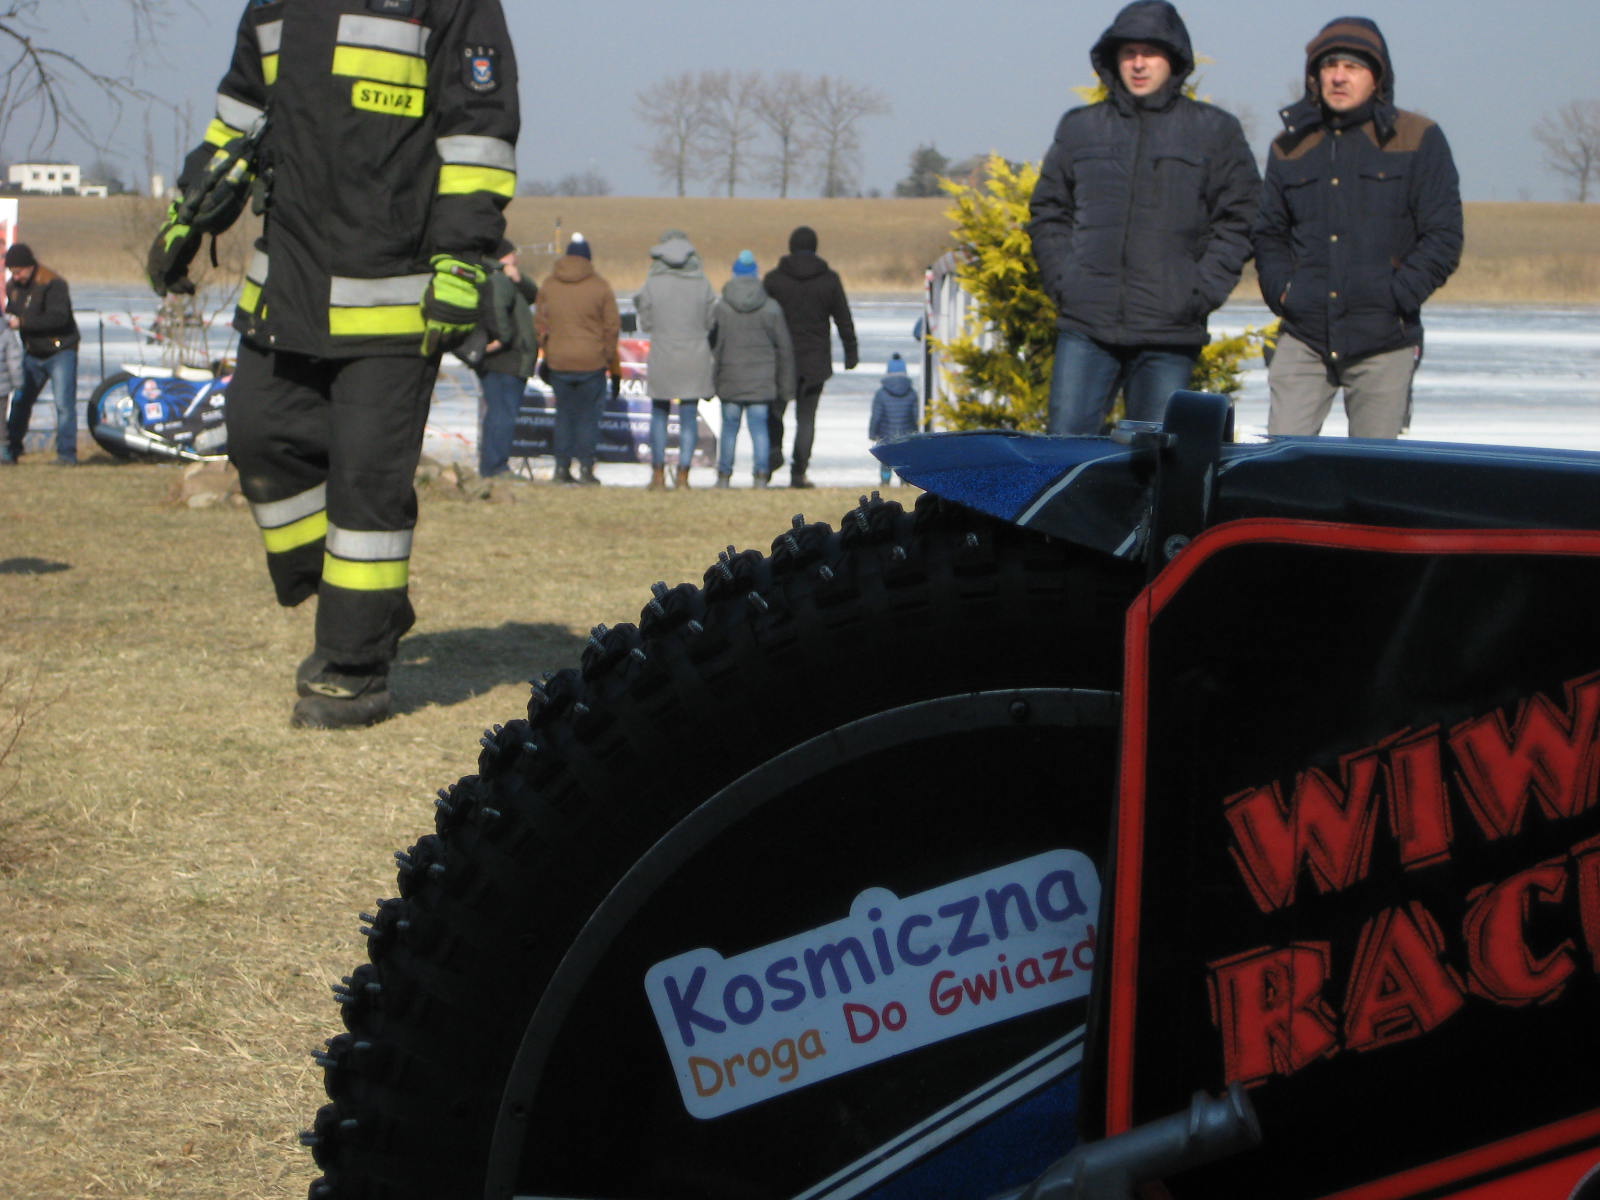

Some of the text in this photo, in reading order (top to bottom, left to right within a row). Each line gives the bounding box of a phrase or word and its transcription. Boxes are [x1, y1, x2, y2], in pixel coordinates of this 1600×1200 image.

[664, 869, 1088, 1047] Kosmiczna
[687, 1028, 827, 1098] Droga
[842, 1001, 907, 1044] Do
